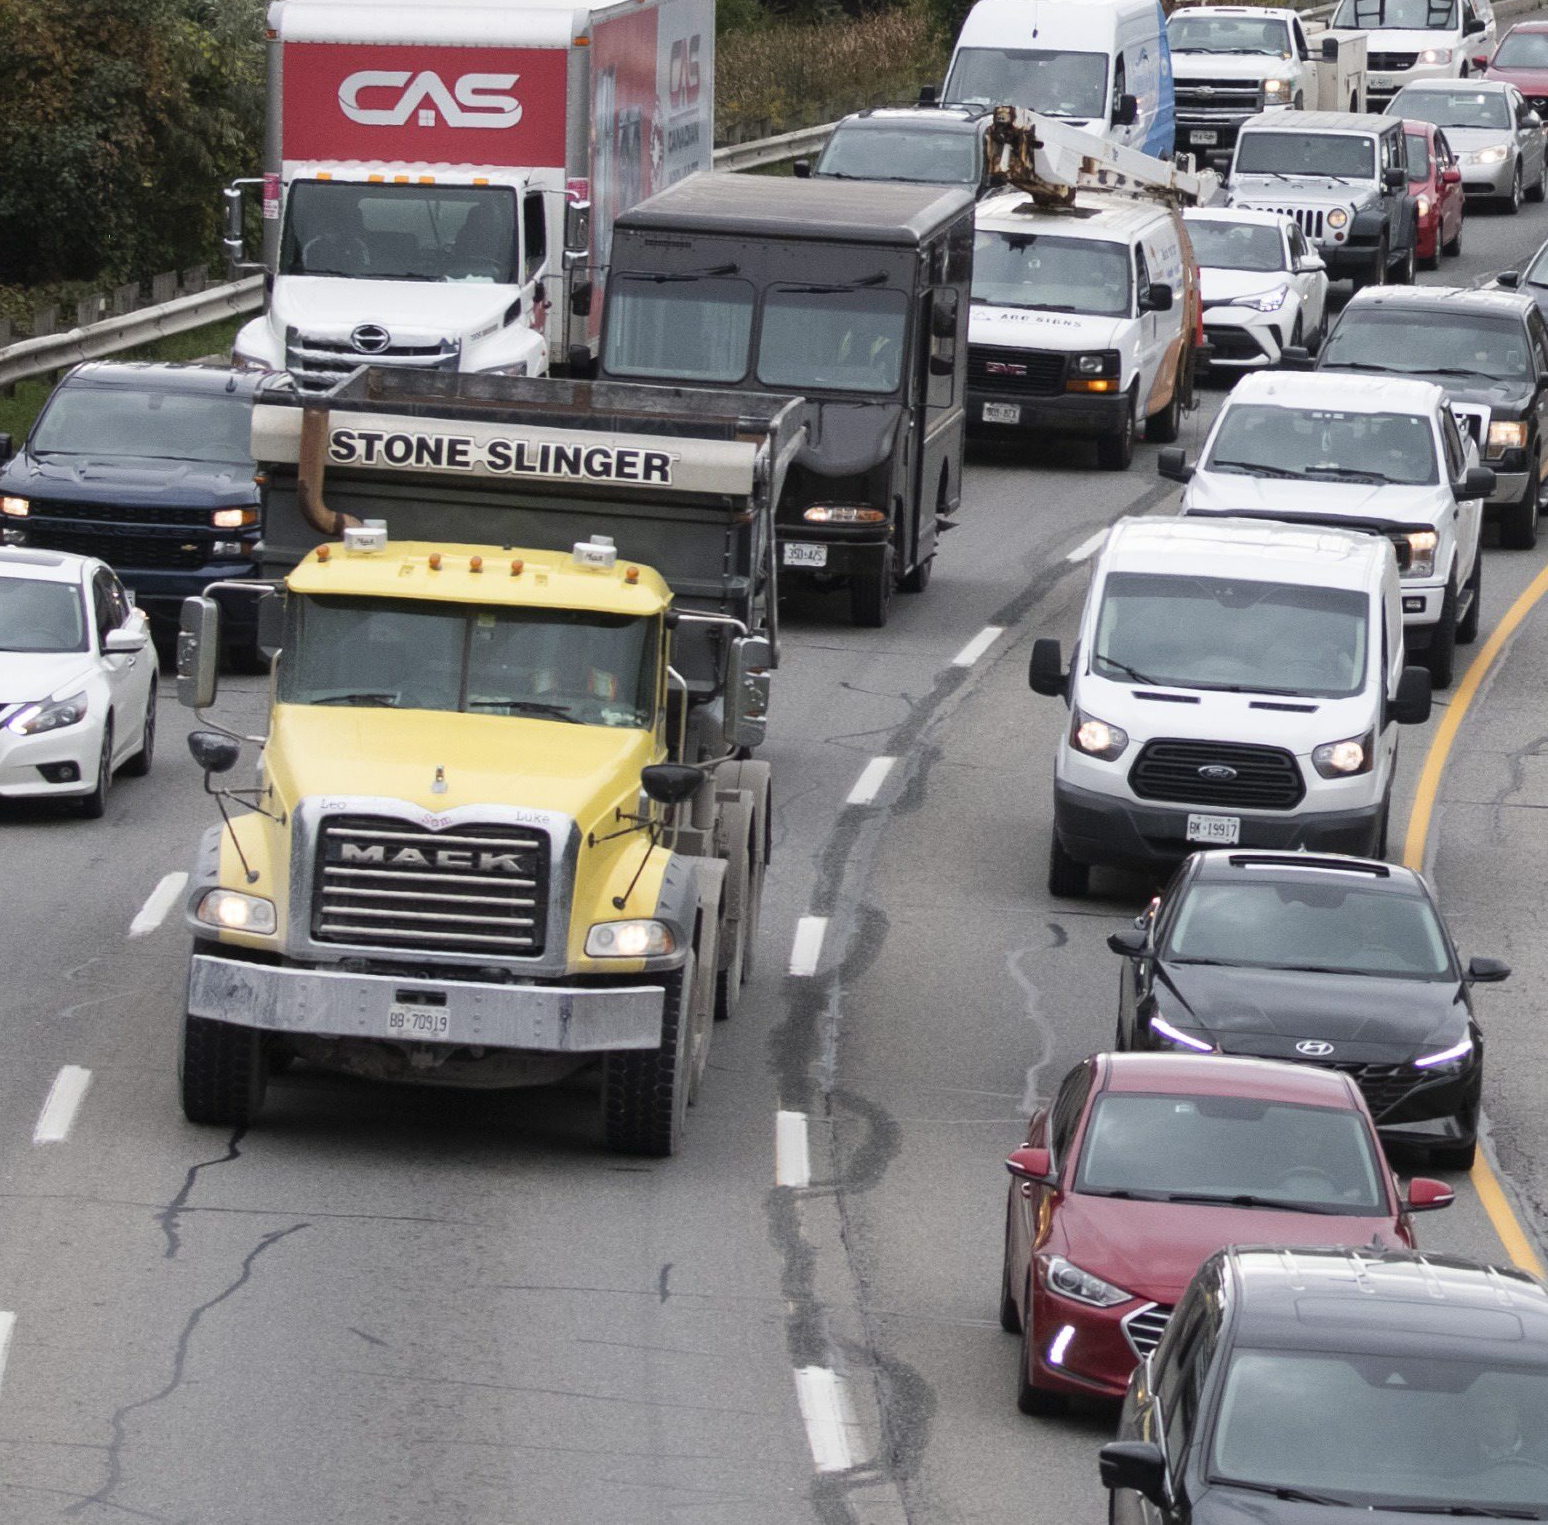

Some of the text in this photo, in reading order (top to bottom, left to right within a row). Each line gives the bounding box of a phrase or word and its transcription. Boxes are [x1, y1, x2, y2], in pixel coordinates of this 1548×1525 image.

[669, 34, 701, 109] CAS
[338, 70, 523, 129] CAS
[986, 361, 1028, 376] GMC
[330, 430, 671, 482] STONE SLINGER
[320, 798, 347, 810] Leo
[421, 814, 453, 828] Sam
[515, 810, 551, 823] Luke
[341, 843, 524, 873] MACK
